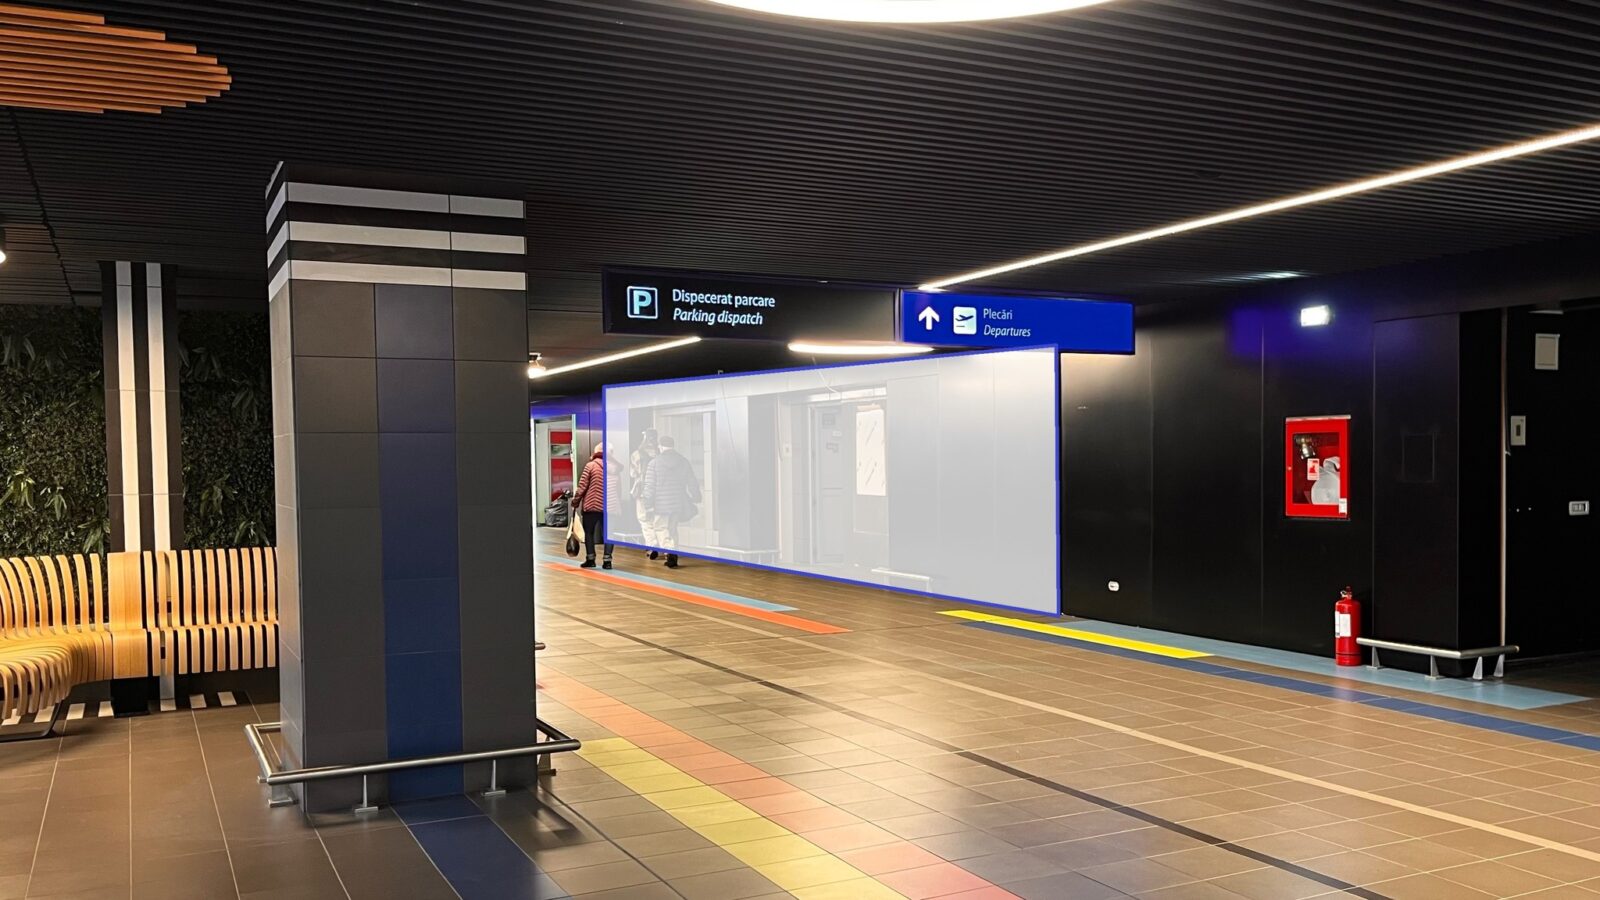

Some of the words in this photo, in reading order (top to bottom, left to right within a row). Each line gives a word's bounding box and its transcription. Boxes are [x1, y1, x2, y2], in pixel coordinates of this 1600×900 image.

[633, 290, 651, 314] P
[672, 288, 732, 305] Dispecerat
[734, 295, 775, 308] parcare
[673, 308, 715, 325] Parking
[717, 310, 763, 326] dispatch
[983, 308, 1013, 320] Plecări
[983, 324, 1031, 338] Departures
